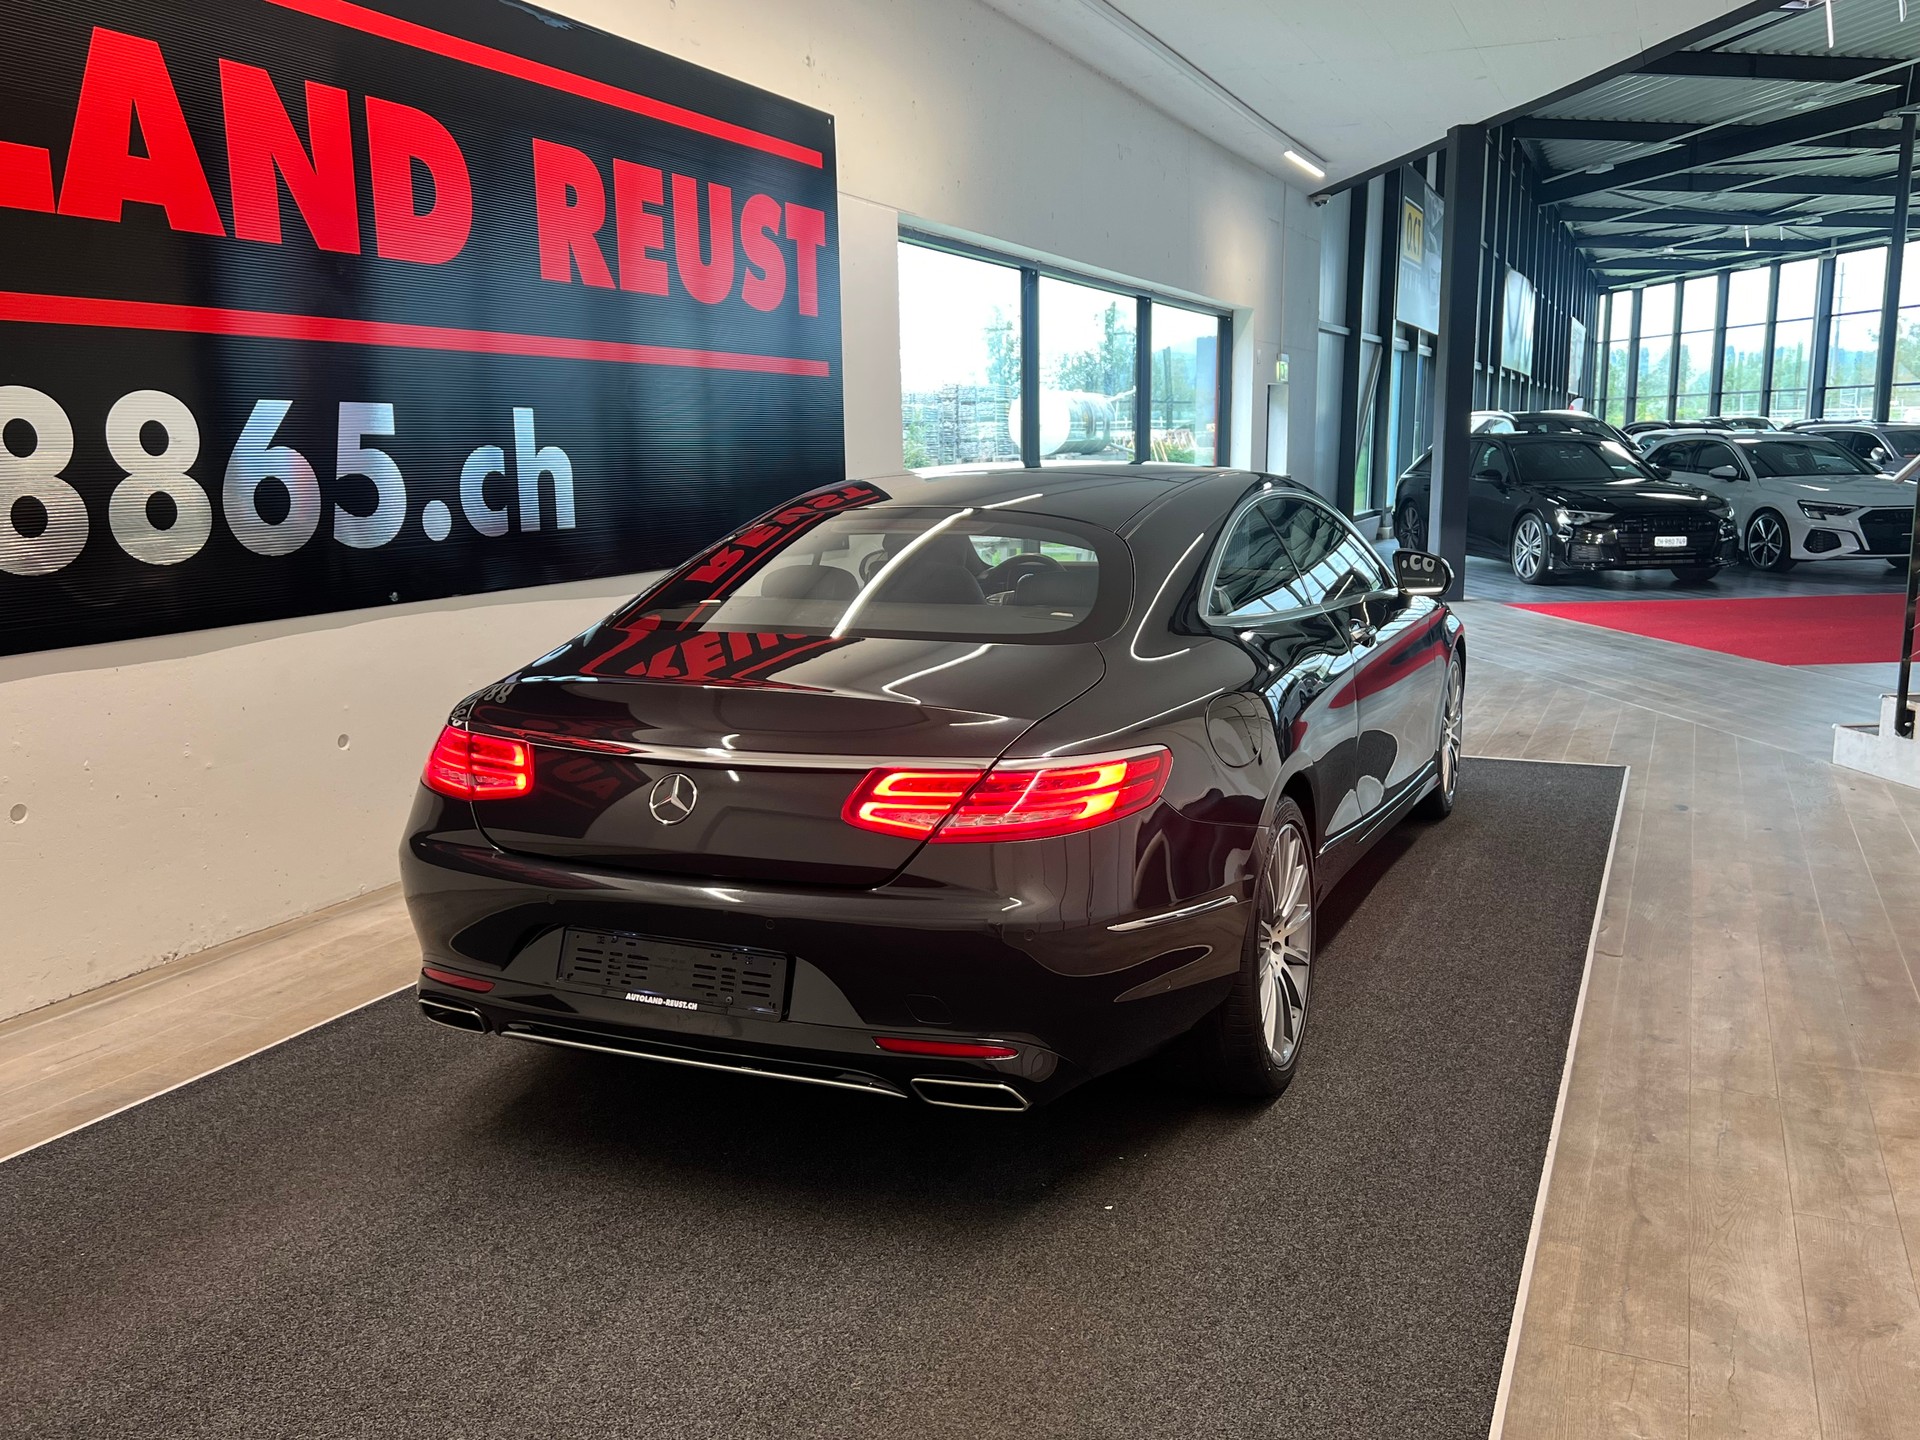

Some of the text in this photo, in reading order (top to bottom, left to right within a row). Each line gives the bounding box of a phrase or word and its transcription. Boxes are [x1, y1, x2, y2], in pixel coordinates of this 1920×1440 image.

[532, 137, 826, 317] REUST
[0, 385, 577, 577] 8865.ch
[625, 992, 698, 1011] AUTOLAND-REUST.CH
